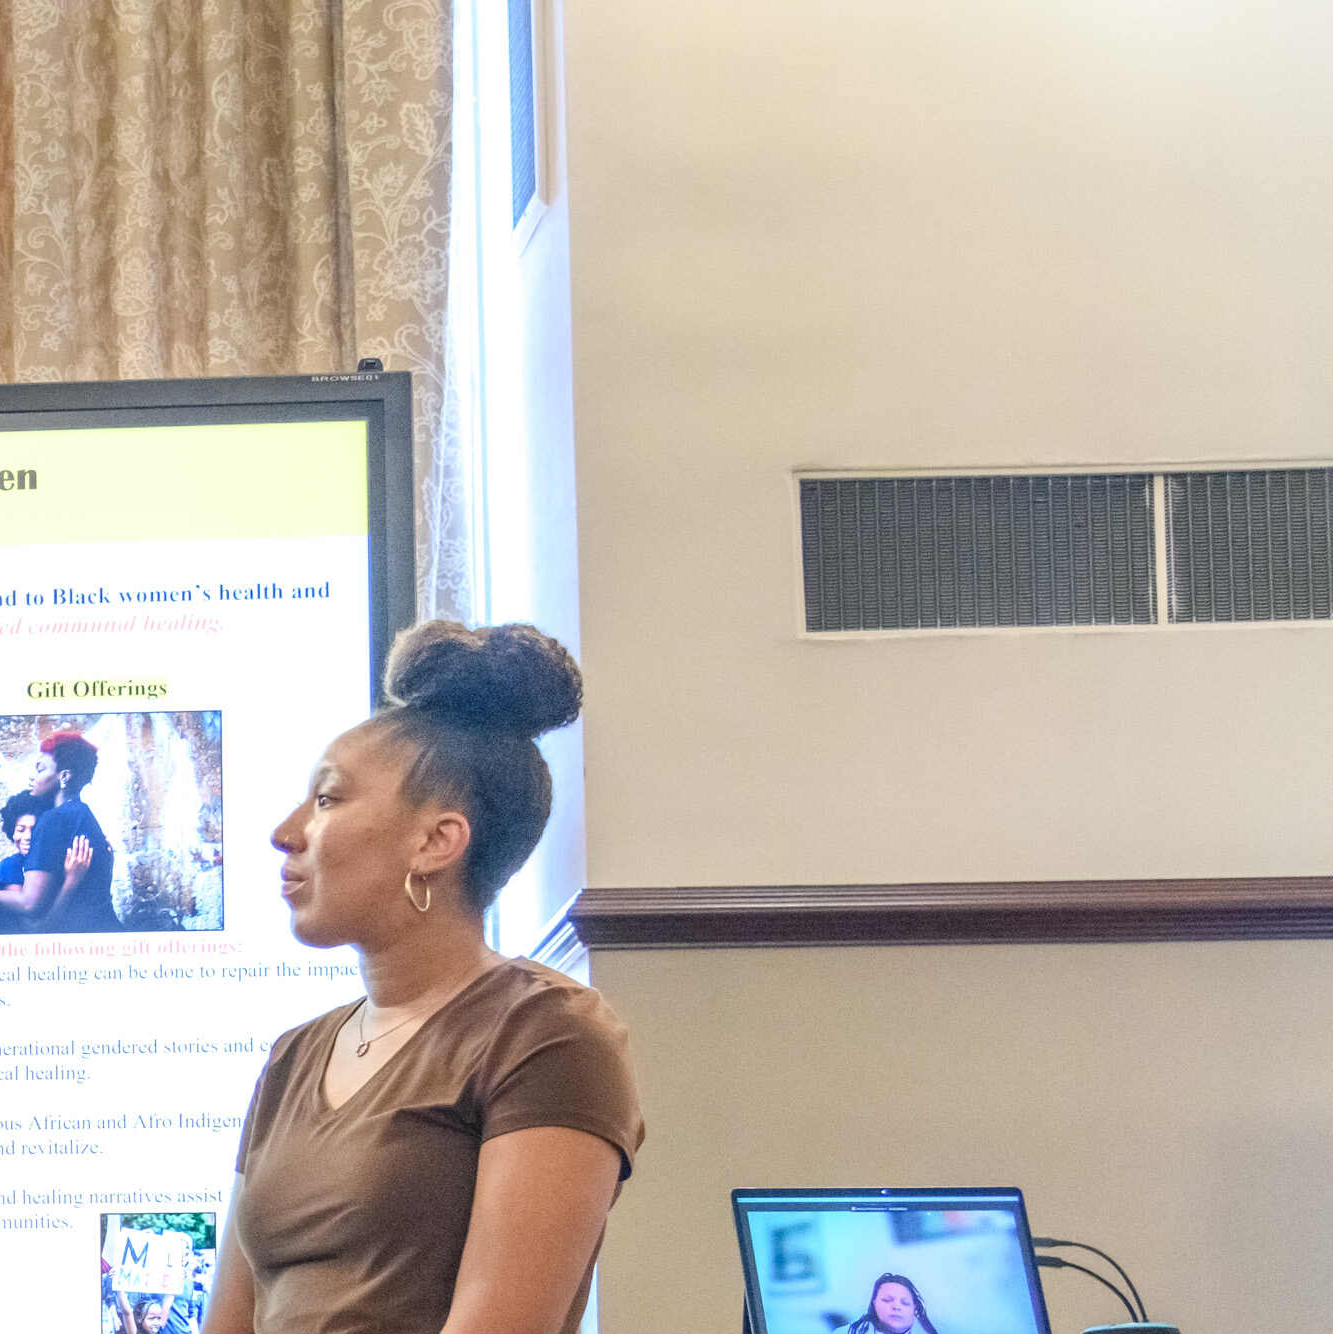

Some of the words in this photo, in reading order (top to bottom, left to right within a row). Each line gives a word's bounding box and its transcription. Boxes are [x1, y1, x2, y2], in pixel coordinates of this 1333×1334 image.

[26, 591, 44, 606] to
[53, 587, 109, 605] Black
[119, 584, 213, 603] women's
[220, 582, 282, 601] health
[292, 581, 329, 600] and
[27, 681, 66, 700] Gift
[71, 679, 167, 700] Offerings
[28, 965, 87, 985] healing
[94, 970, 122, 980] can
[153, 964, 193, 979] done
[221, 963, 272, 982] repair
[276, 963, 301, 978] the
[81, 1038, 157, 1059] gendered
[165, 1037, 218, 1054] stories
[224, 1036, 253, 1053] and
[29, 1114, 90, 1131] African
[98, 1113, 126, 1129] and
[133, 1112, 172, 1129] Afro
[22, 1188, 82, 1208] healing
[88, 1188, 171, 1204] narratives
[176, 1188, 222, 1203] assist
